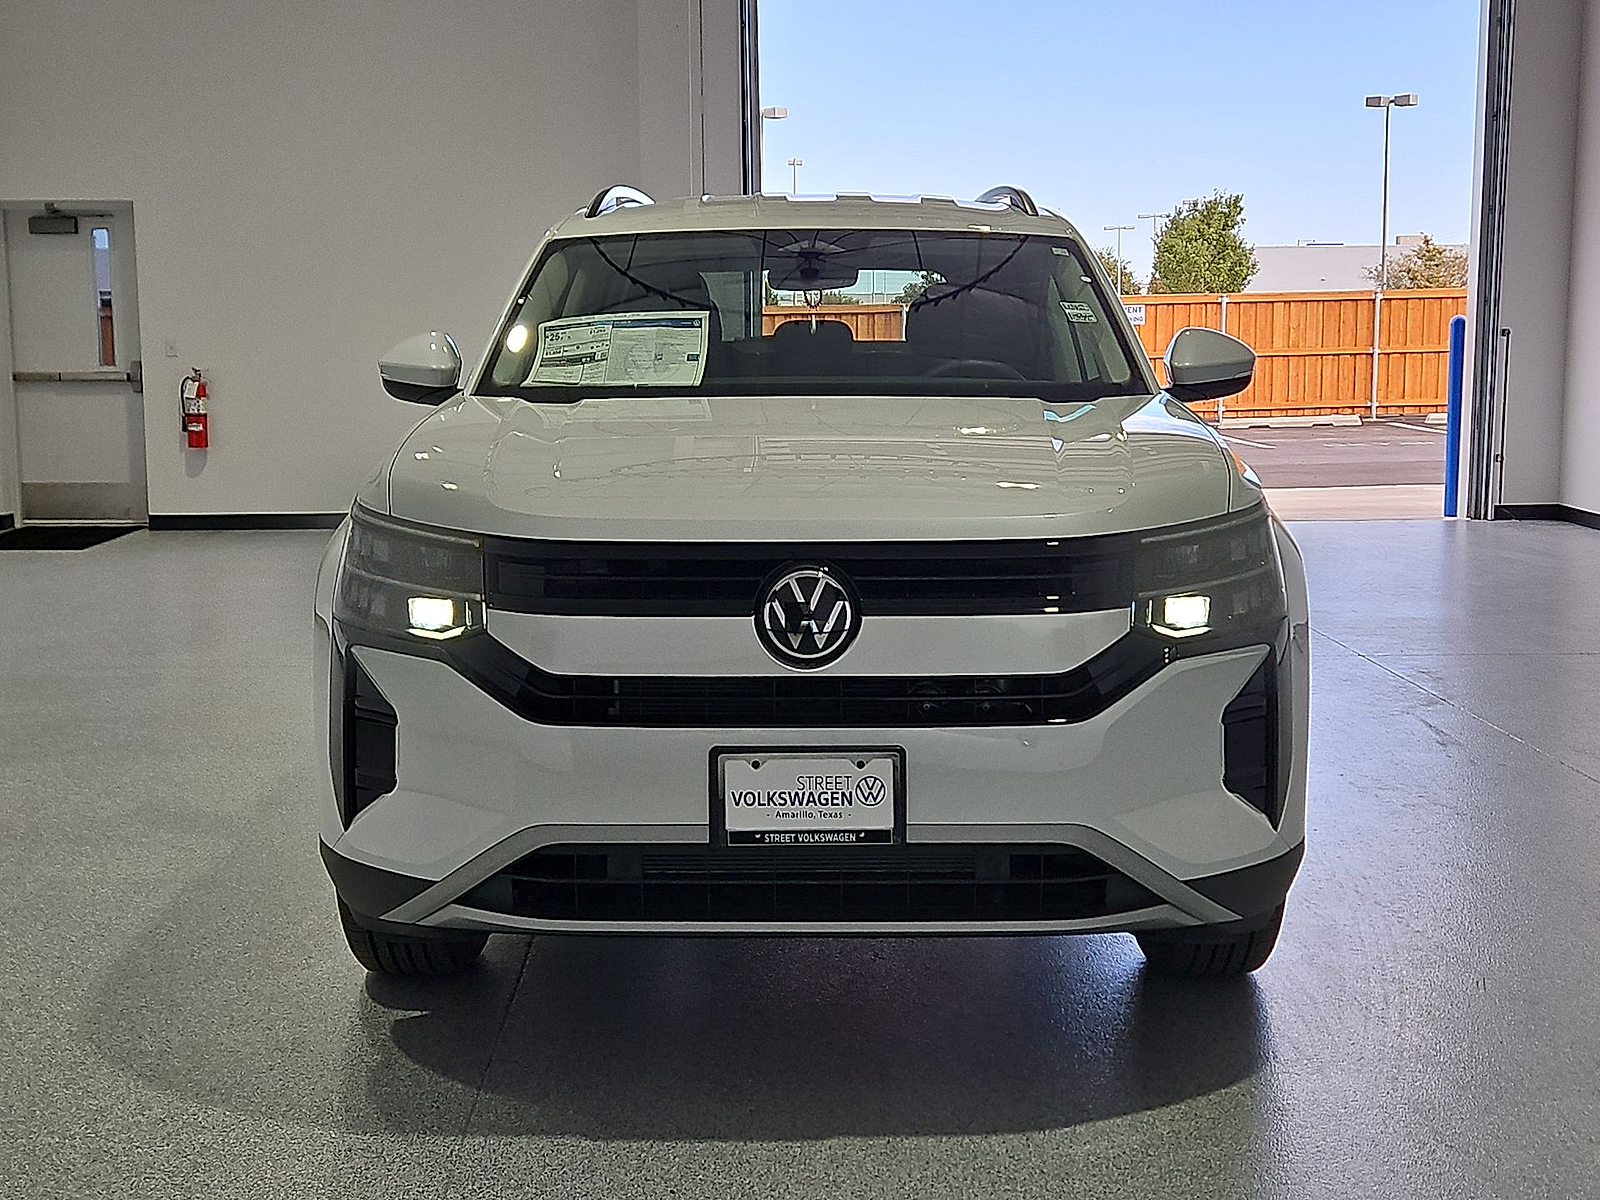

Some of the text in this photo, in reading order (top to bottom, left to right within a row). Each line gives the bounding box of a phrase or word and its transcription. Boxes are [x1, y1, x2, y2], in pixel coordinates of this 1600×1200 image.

[549, 331, 560, 342] 25
[796, 775, 853, 791] STREET
[731, 791, 853, 807] VOLKSWAGEN
[775, 810, 843, 820] Amarillo, Texas
[764, 832, 857, 843] STREET VOLKSWAGEN
